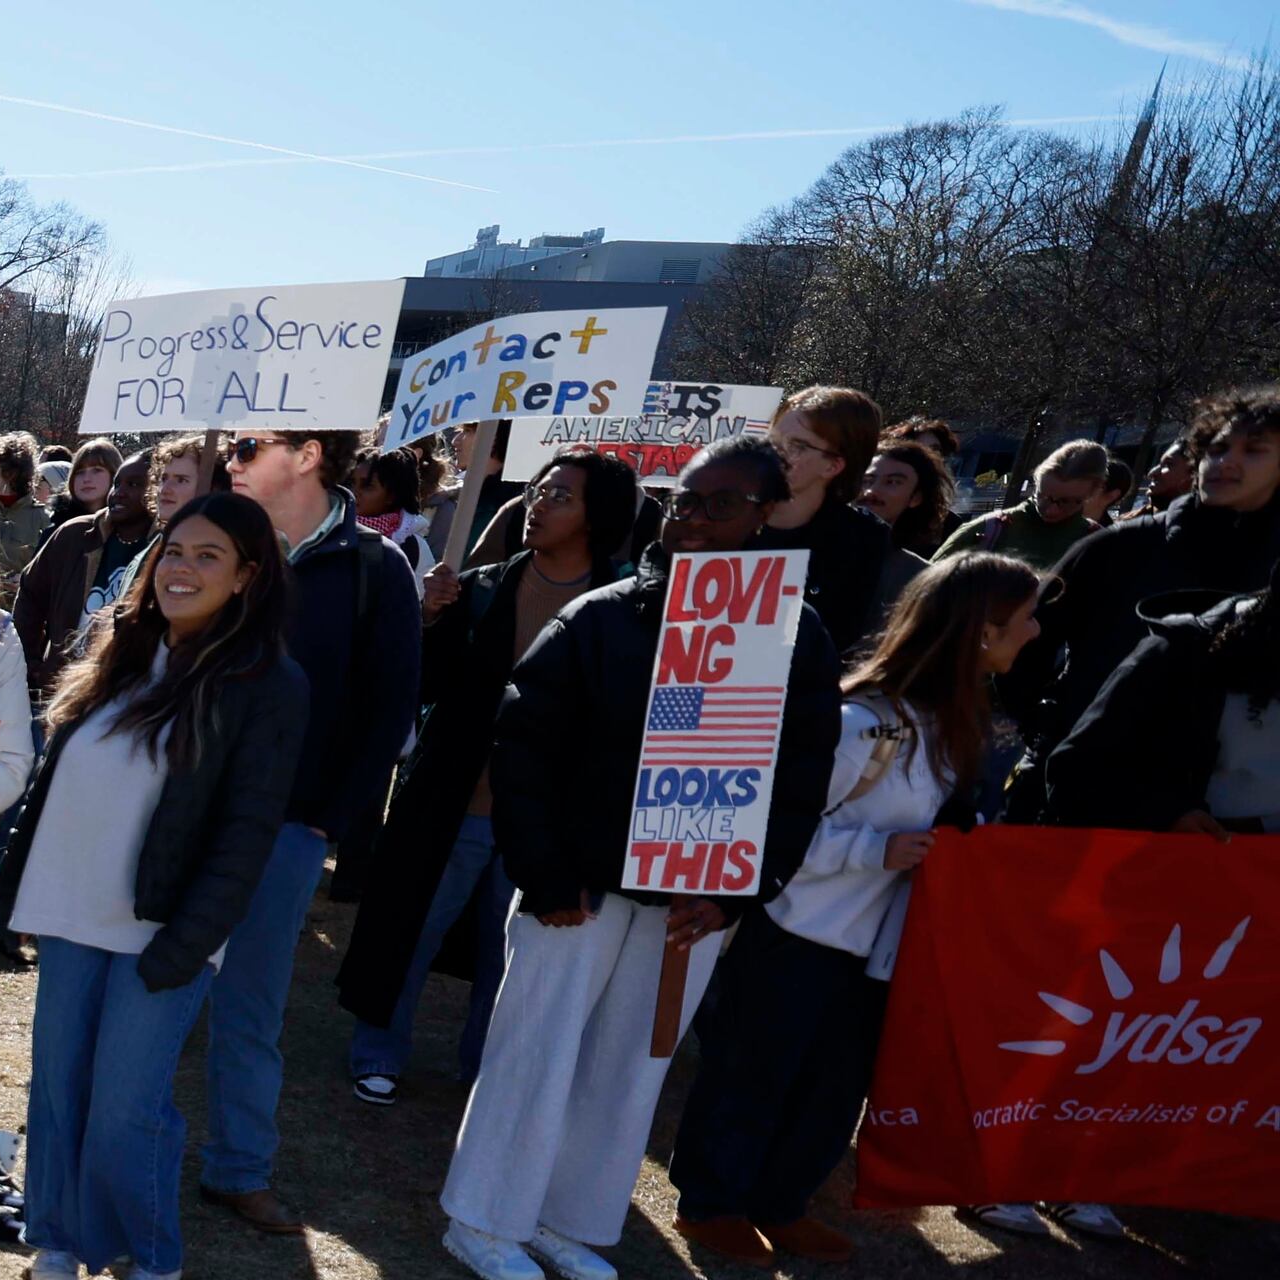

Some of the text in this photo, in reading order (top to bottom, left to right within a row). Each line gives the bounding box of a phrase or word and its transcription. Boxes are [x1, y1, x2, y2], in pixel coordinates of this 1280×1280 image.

[410, 316, 608, 394] Contact
[114, 371, 307, 420] FOR ALL
[401, 371, 617, 440] Your Reps
[668, 385, 723, 418] IS
[543, 415, 746, 444] AMERICAN
[656, 624, 736, 685] NG
[635, 767, 761, 807] LOOKS
[632, 807, 735, 842] LIKE
[630, 840, 757, 892] THIS
[1074, 1000, 1263, 1074] ydsa
[1053, 1099, 1197, 1123] Socialists
[1206, 1100, 1249, 1125] of
